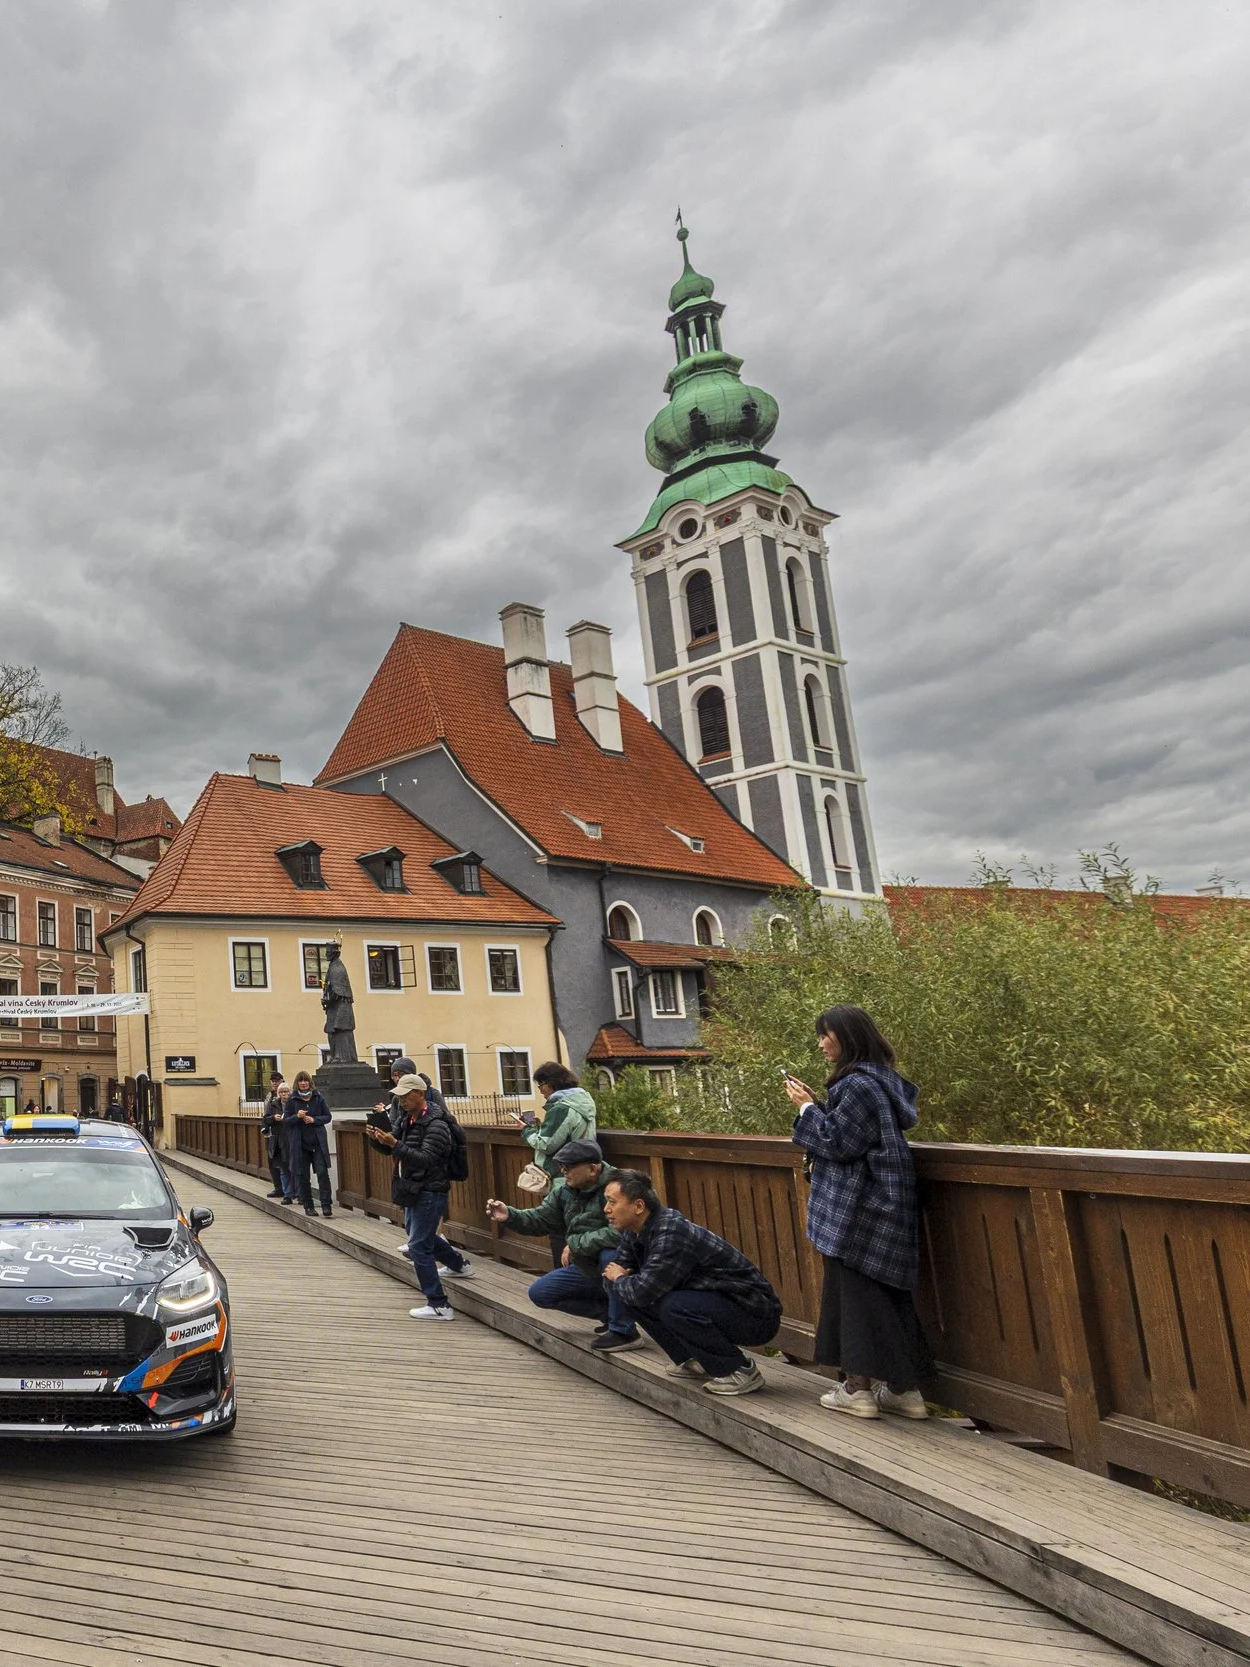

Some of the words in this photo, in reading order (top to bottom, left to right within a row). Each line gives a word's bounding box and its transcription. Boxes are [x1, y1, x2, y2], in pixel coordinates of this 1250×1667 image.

[25, 998, 47, 1008] Český
[36, 1244, 133, 1264] JUNIOR
[23, 1251, 137, 1281] WRC
